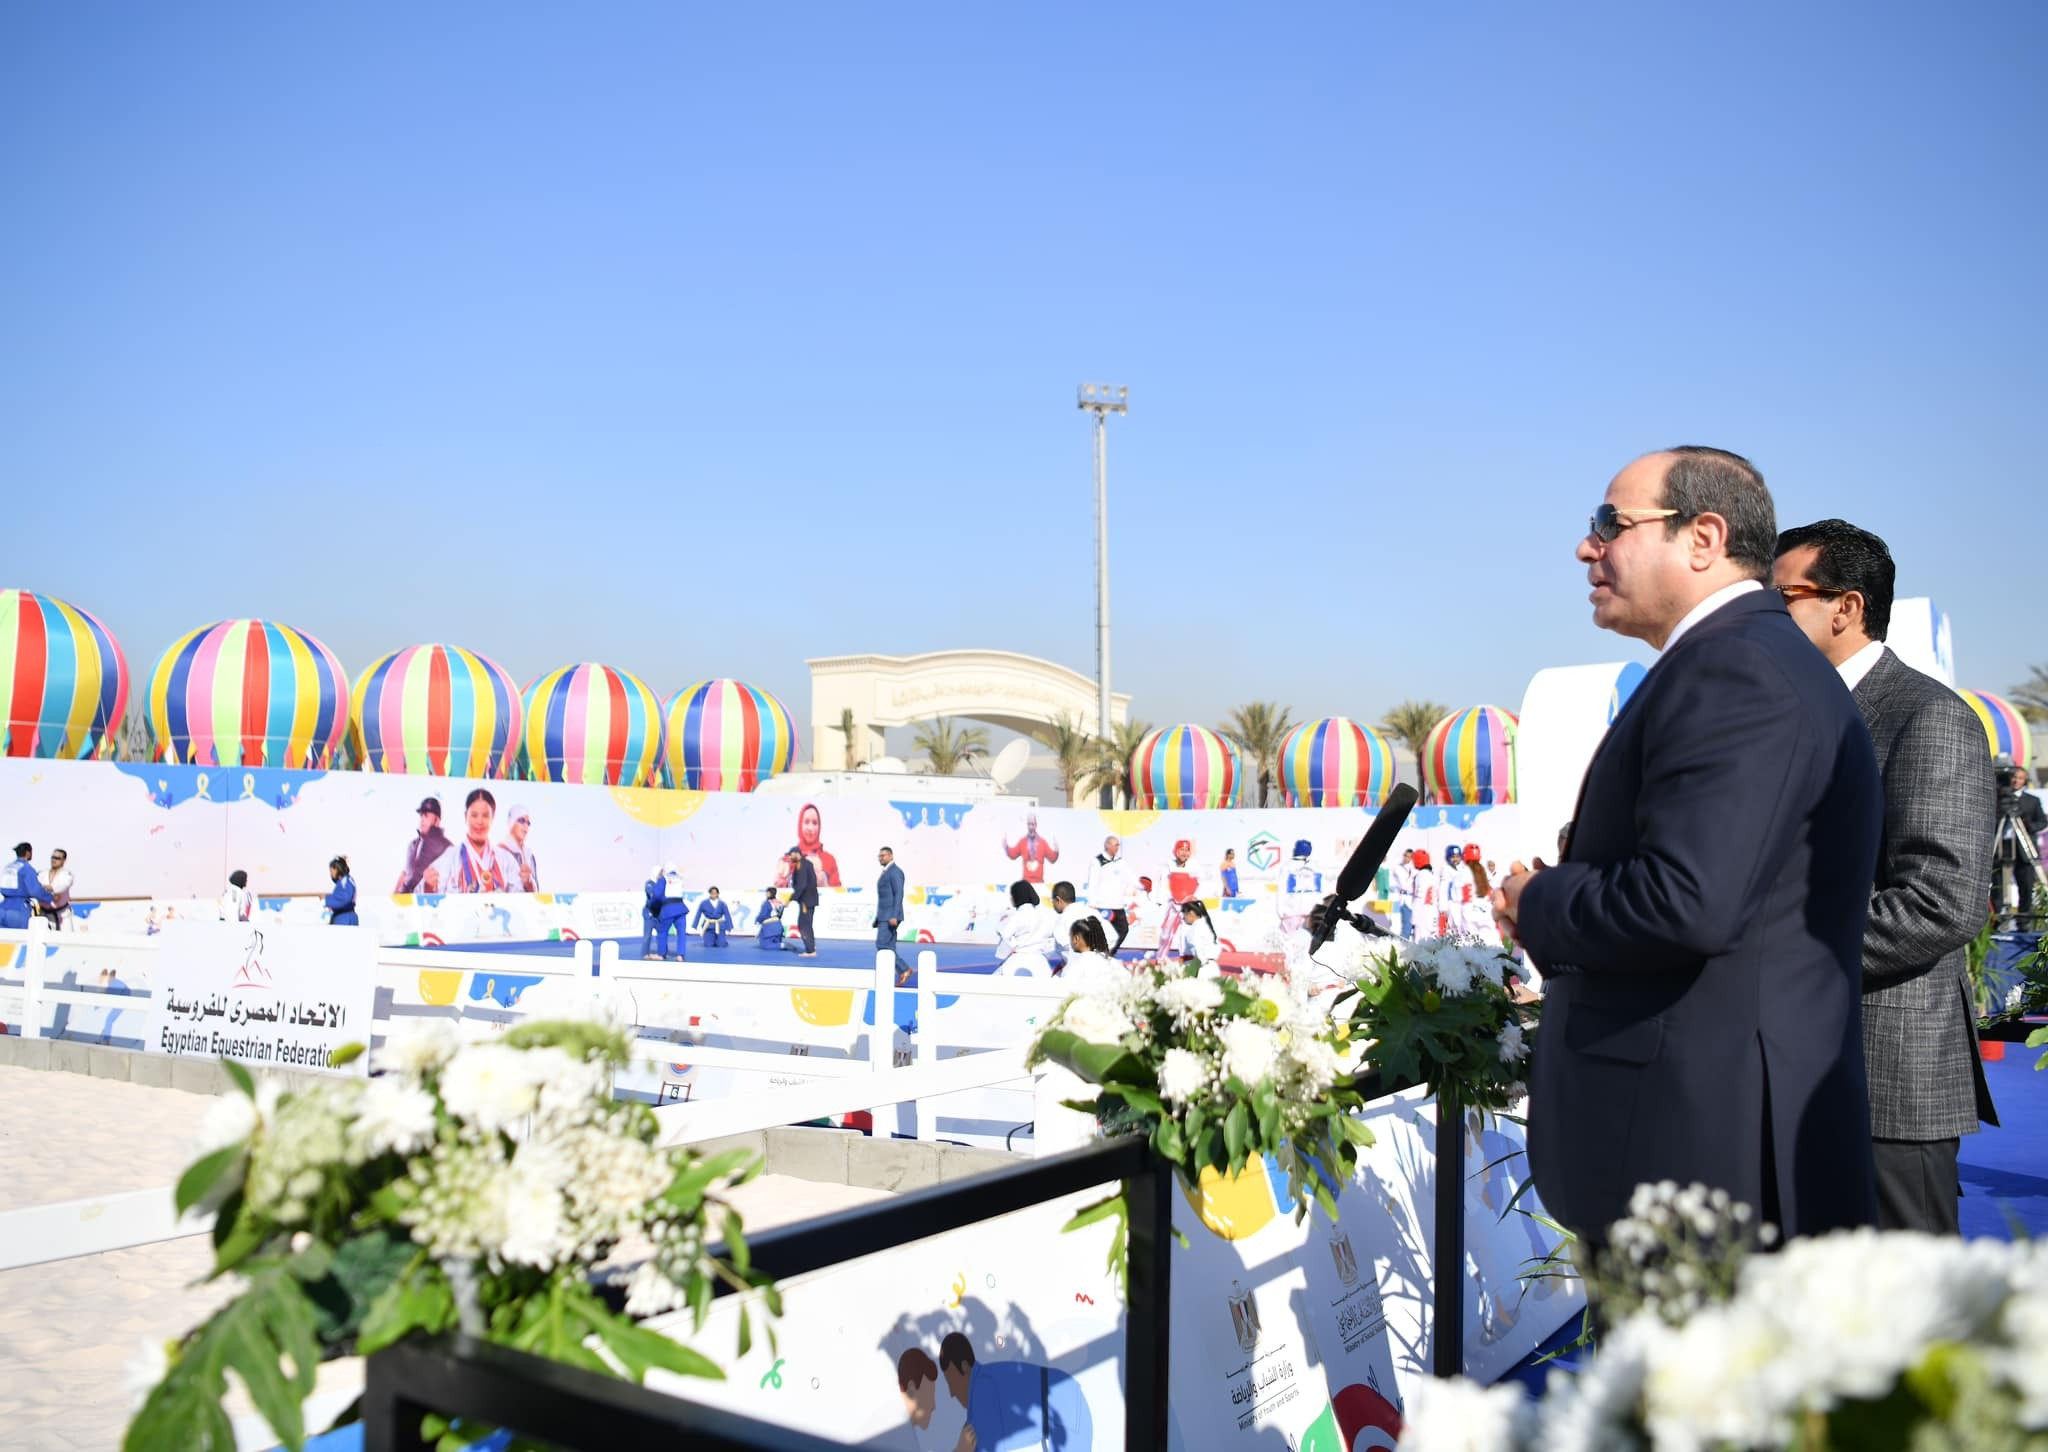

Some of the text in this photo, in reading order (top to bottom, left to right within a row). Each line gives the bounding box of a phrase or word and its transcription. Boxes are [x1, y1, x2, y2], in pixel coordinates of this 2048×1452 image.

[166, 987, 228, 1022] للفروسية
[290, 1001, 346, 1028] الاتحاد
[161, 1026, 341, 1069] Egyptian Equestrian Federatio
